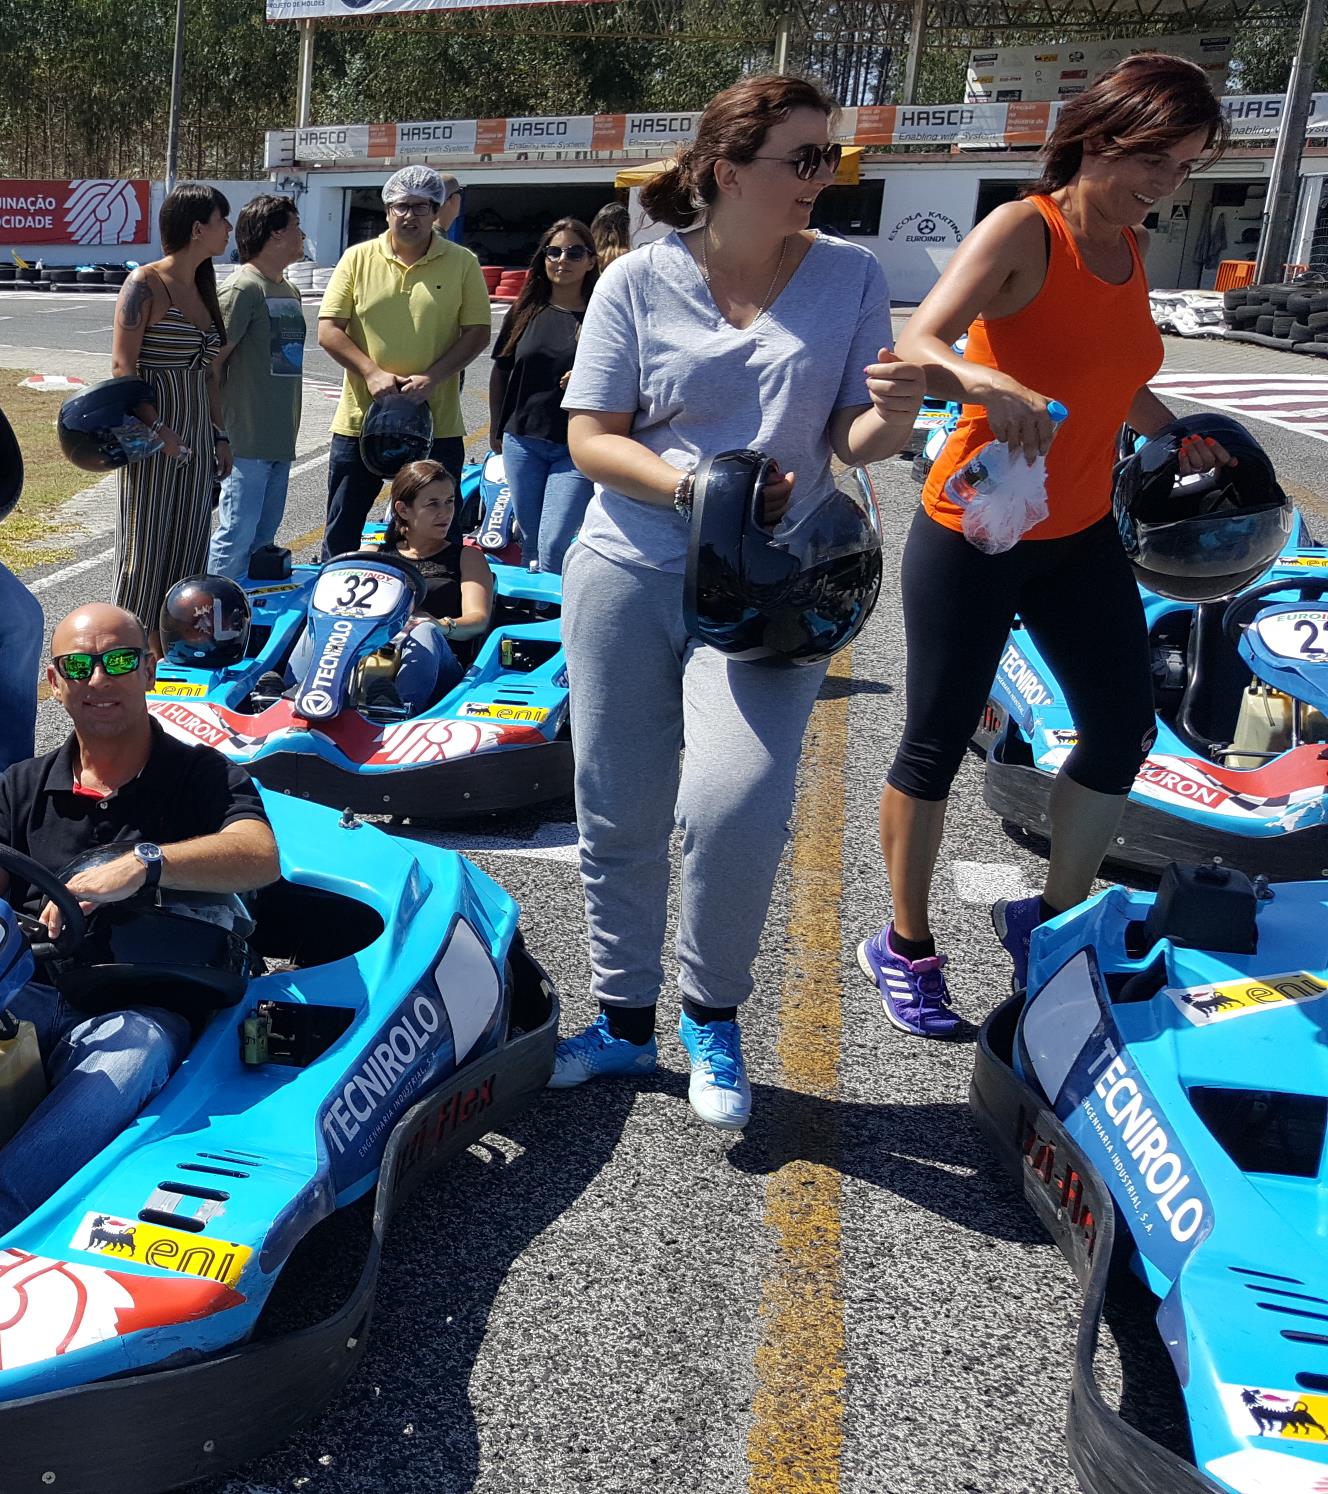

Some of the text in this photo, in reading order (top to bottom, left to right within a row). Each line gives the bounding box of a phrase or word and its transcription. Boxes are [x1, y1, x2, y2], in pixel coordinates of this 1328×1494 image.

[400, 125, 453, 141] HASCO
[510, 121, 568, 137] HASCO
[630, 117, 692, 134] HASCO
[901, 109, 975, 127] HASCO
[1232, 124, 1270, 137] nabling
[298, 130, 347, 146] HASCO
[888, 211, 964, 243] ESCOLA KARTING
[330, 570, 394, 582] EUROINDY
[336, 574, 379, 609] 32
[1293, 619, 1328, 654] 2
[161, 683, 203, 697] eni
[163, 705, 224, 744] HURON
[496, 707, 541, 722] eni
[1245, 974, 1328, 1005] eni
[321, 995, 440, 1155] TECNIROLO
[359, 1108, 395, 1158] ENGENHARIA
[1080, 1096, 1113, 1154] ENGENHARIA
[1086, 1037, 1205, 1243] TECNIROLO
[144, 1240, 240, 1285] eni
